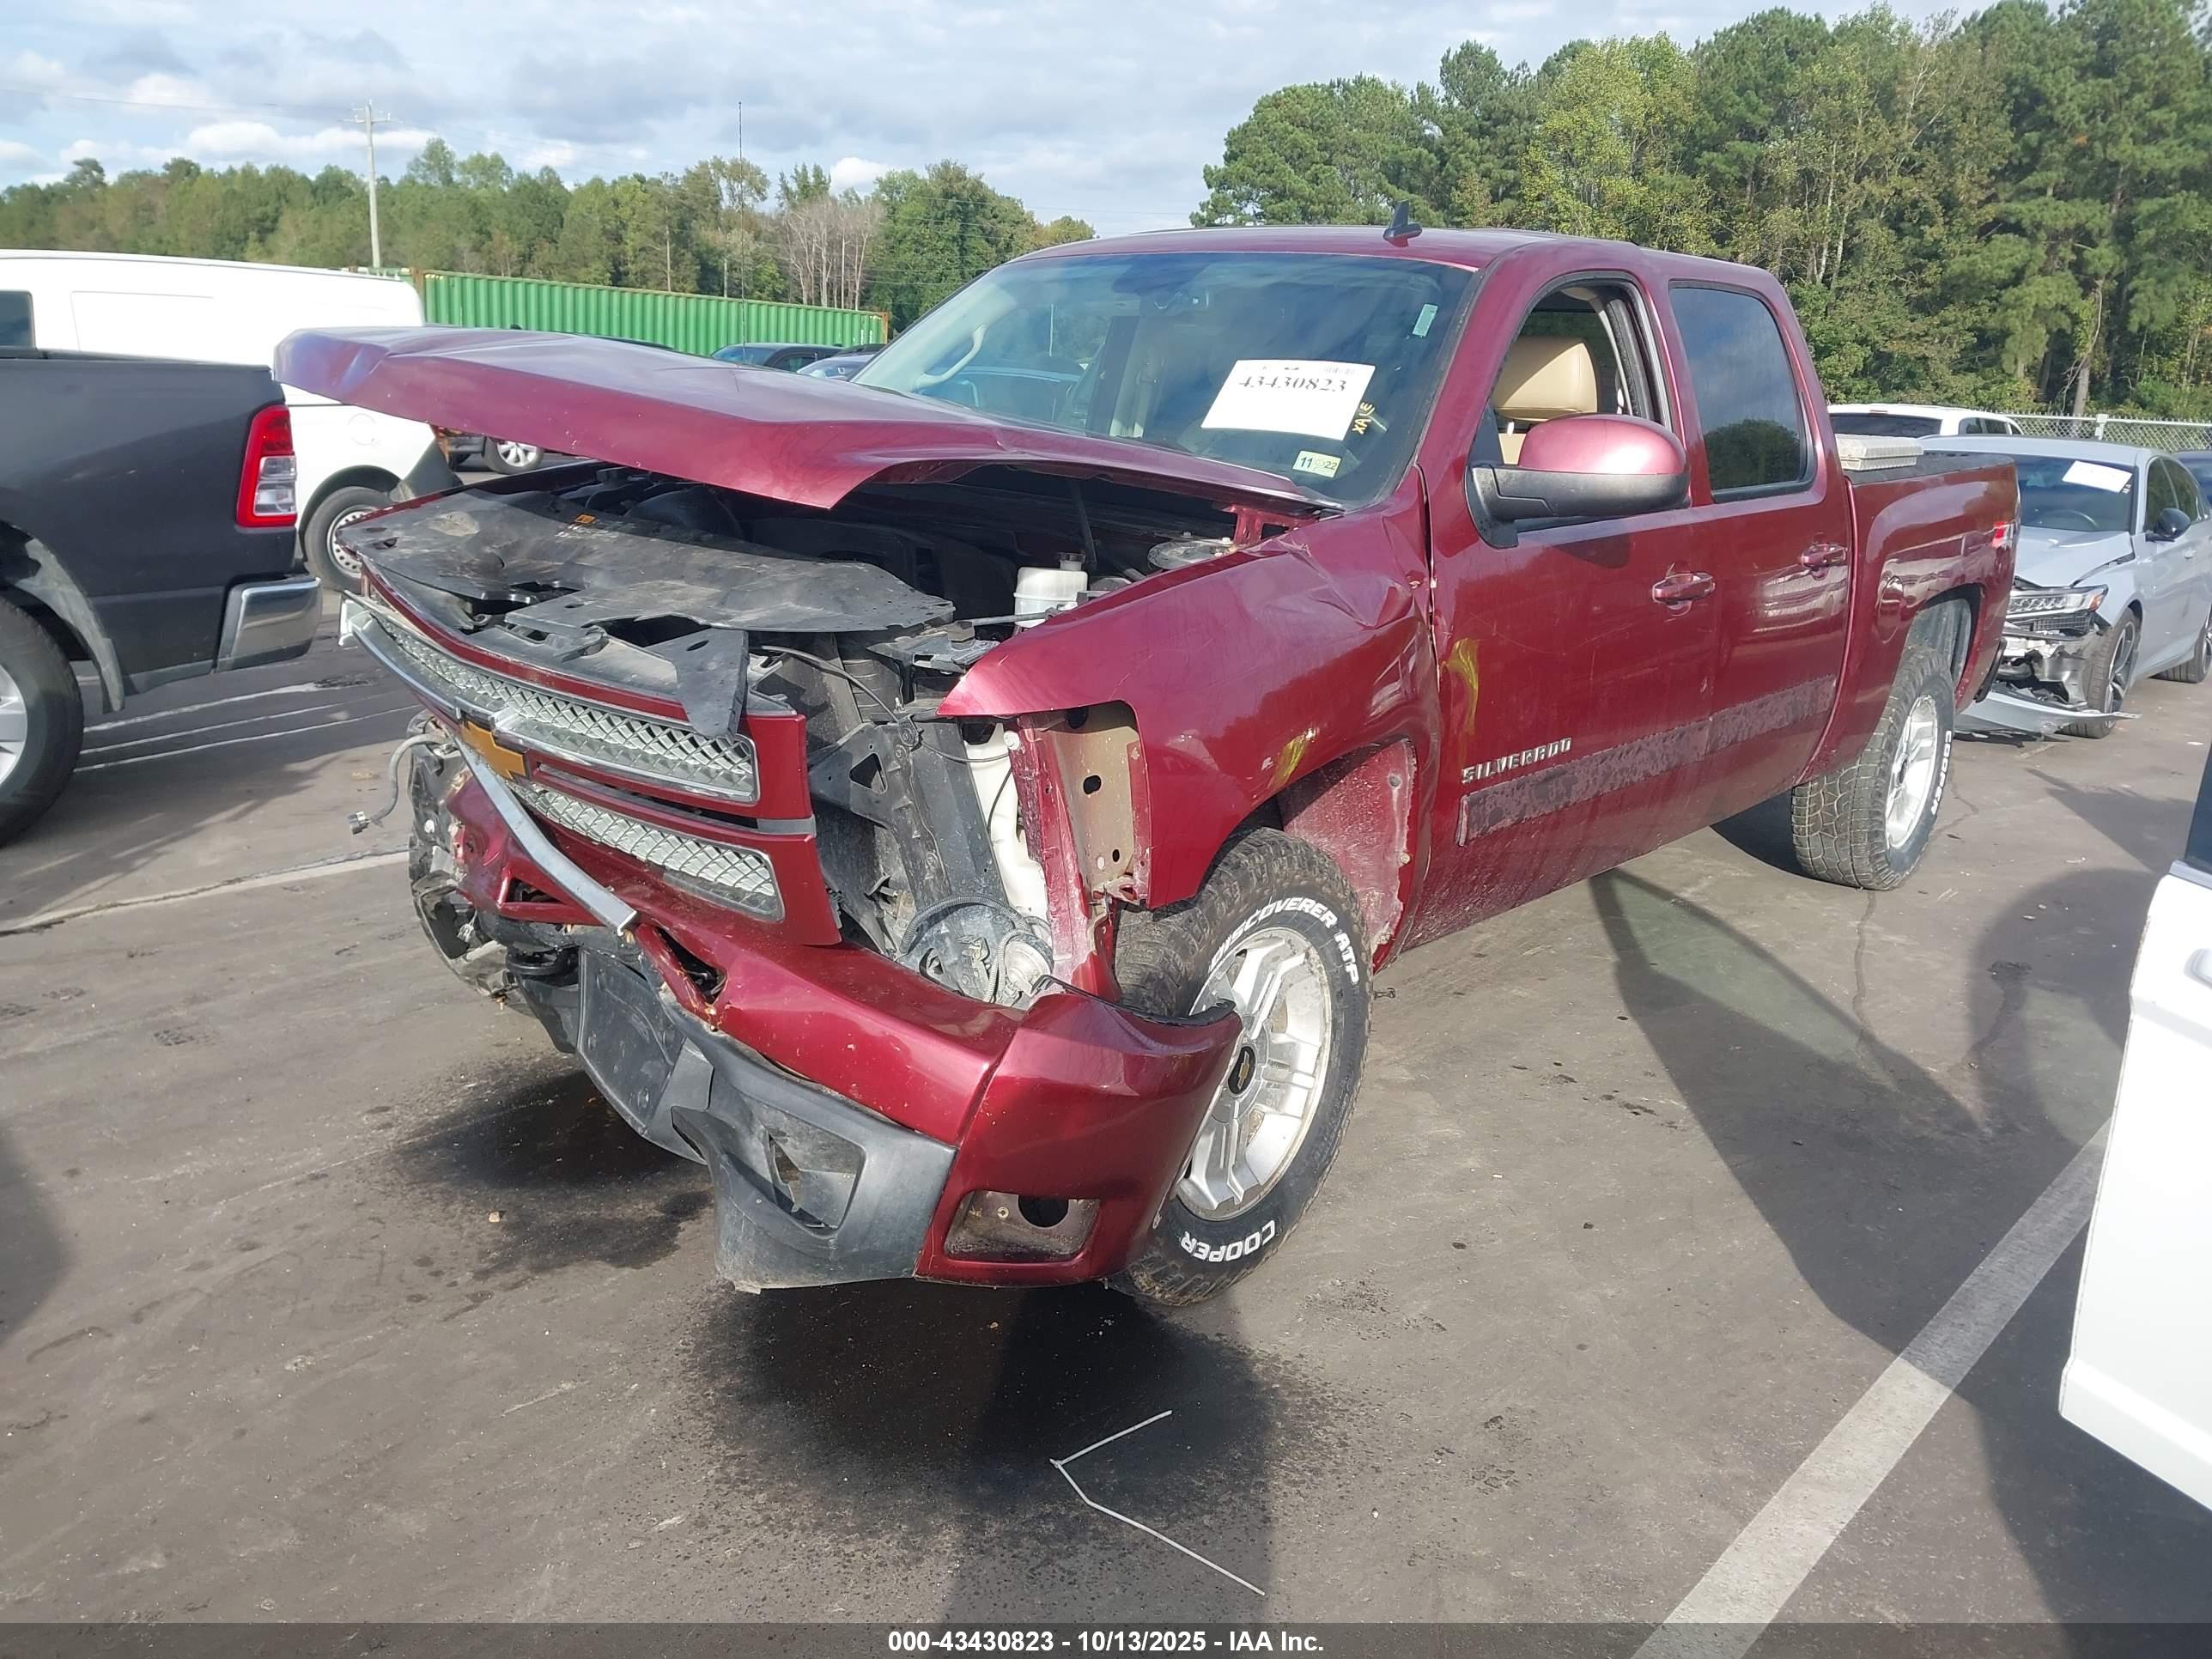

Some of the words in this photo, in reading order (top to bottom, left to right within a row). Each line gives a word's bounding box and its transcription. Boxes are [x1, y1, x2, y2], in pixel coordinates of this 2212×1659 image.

[1238, 376, 1347, 392] 43430823
[1300, 457, 1312, 467] 11
[1462, 738, 1572, 784] SILVERADO
[1181, 1219, 1275, 1262] COOPER
